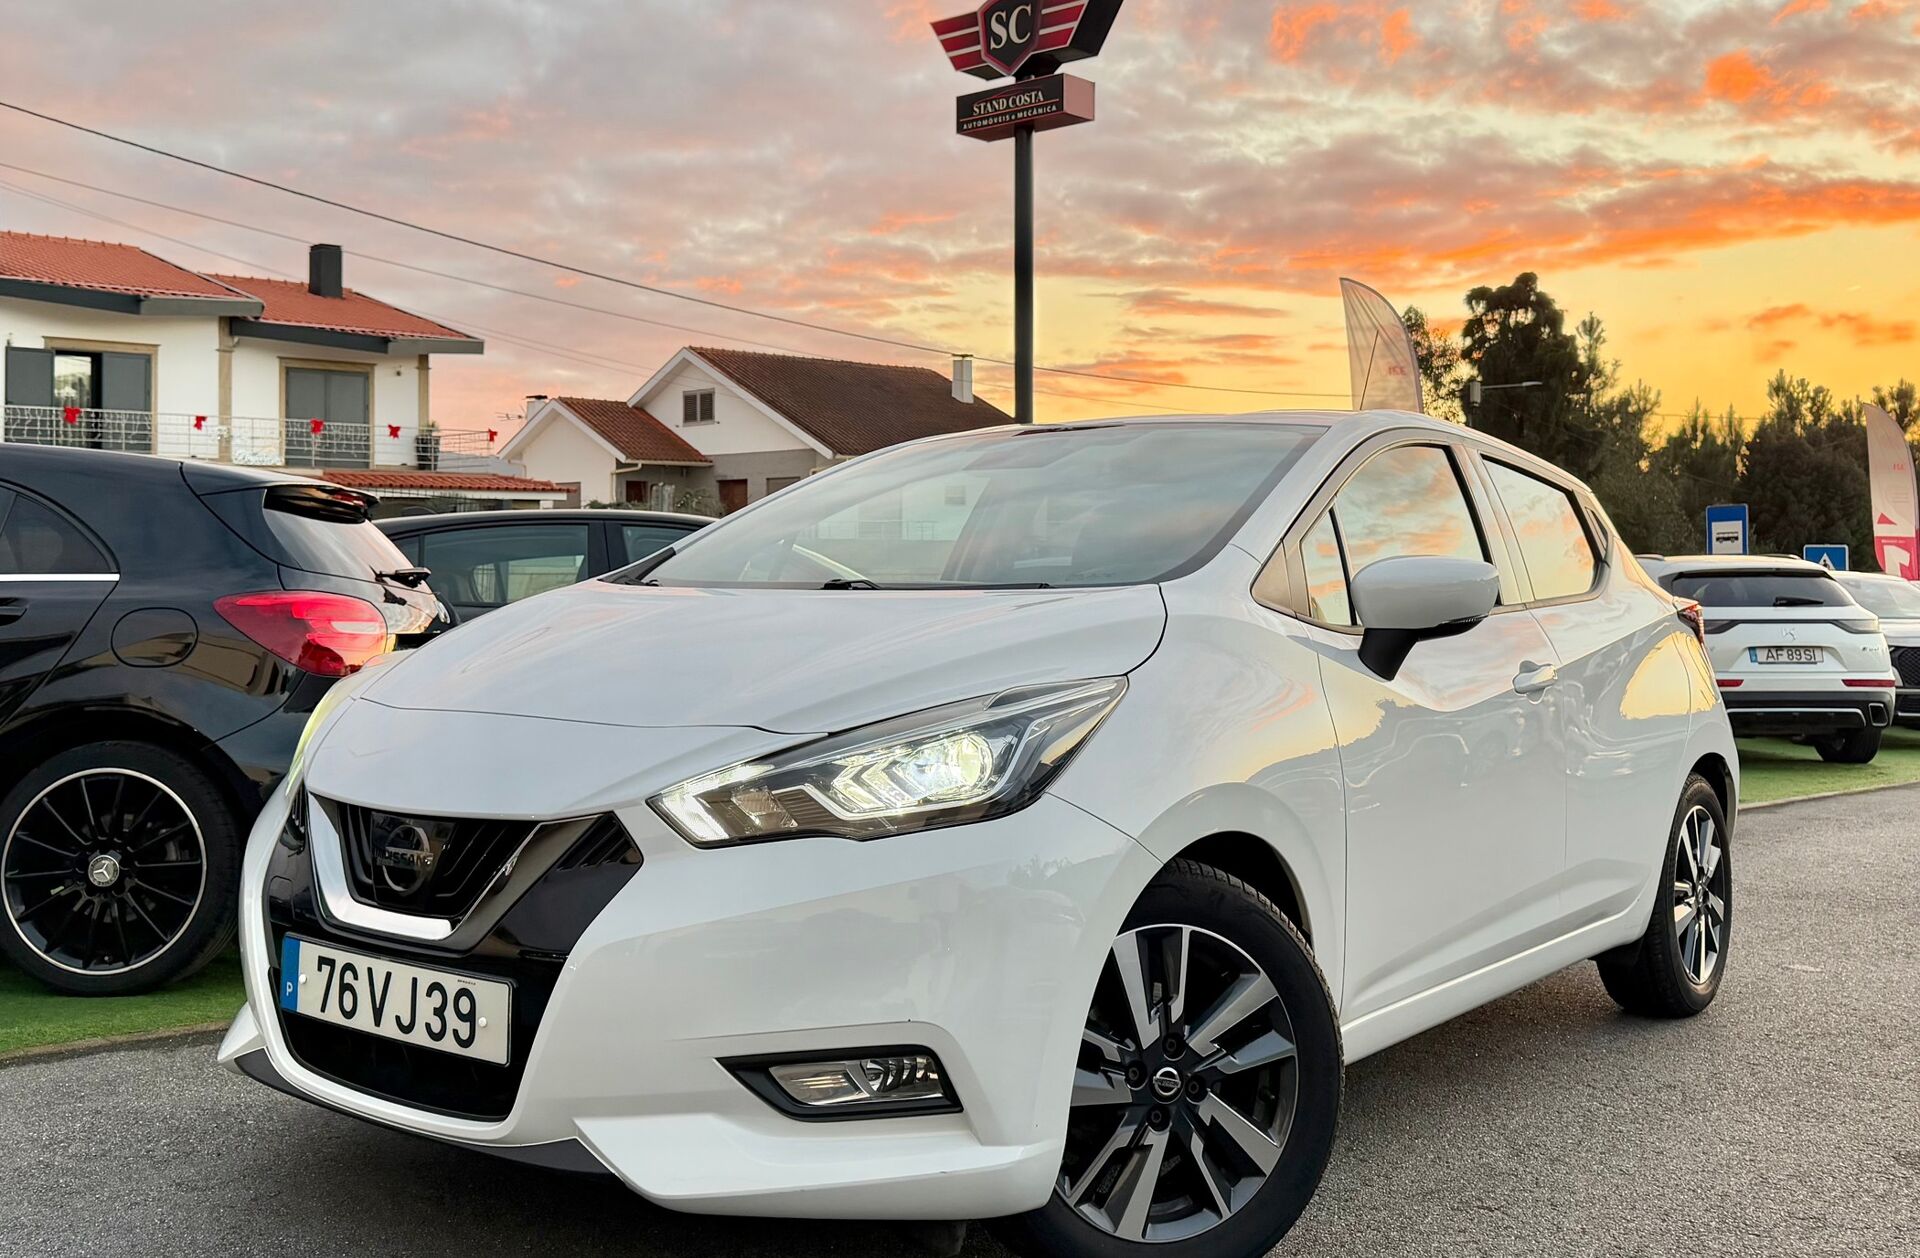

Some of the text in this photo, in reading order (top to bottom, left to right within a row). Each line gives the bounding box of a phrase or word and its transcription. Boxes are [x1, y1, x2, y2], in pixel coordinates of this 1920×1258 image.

[990, 4, 1032, 49] SC
[973, 90, 1044, 116] STAND COSTA
[1017, 104, 1057, 118] MECÂNICA
[1766, 648, 1784, 660] AF
[1787, 649, 1802, 661] 89
[1804, 649, 1816, 661] SI
[286, 981, 293, 997] P
